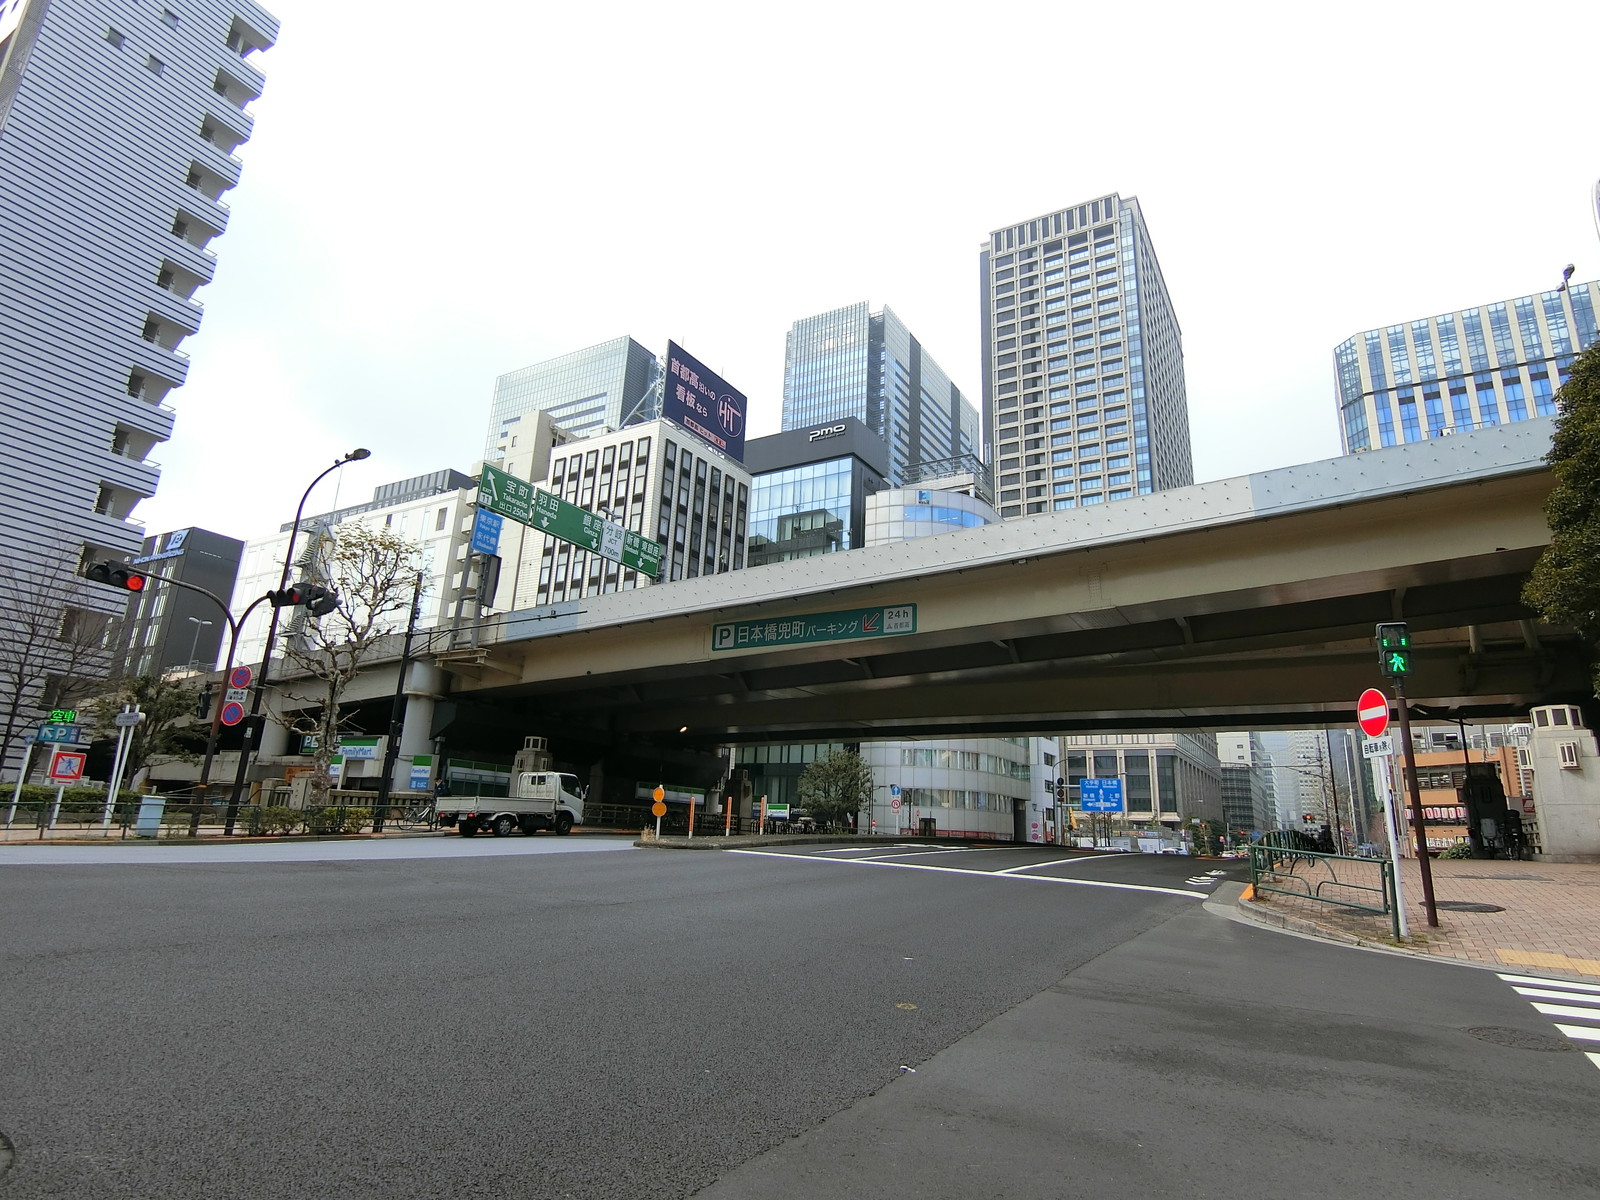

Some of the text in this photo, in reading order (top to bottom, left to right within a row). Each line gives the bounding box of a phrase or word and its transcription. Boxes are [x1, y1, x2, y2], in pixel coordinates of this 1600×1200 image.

[671, 358, 716, 401] 首都高沿いの
[676, 384, 708, 417] 看板なら
[505, 480, 529, 499] 宝町
[503, 492, 528, 510] Takaracho
[538, 493, 559, 512] 羽田
[536, 505, 557, 520] Haneda
[582, 514, 602, 532] 銀座
[583, 526, 598, 538] Ginza
[608, 538, 618, 546] JCT
[604, 546, 619, 558] 700m
[888, 609, 909, 620] 24h
[49, 709, 76, 722] 空車
[55, 727, 67, 741] P
[341, 746, 373, 758] FamilyMart
